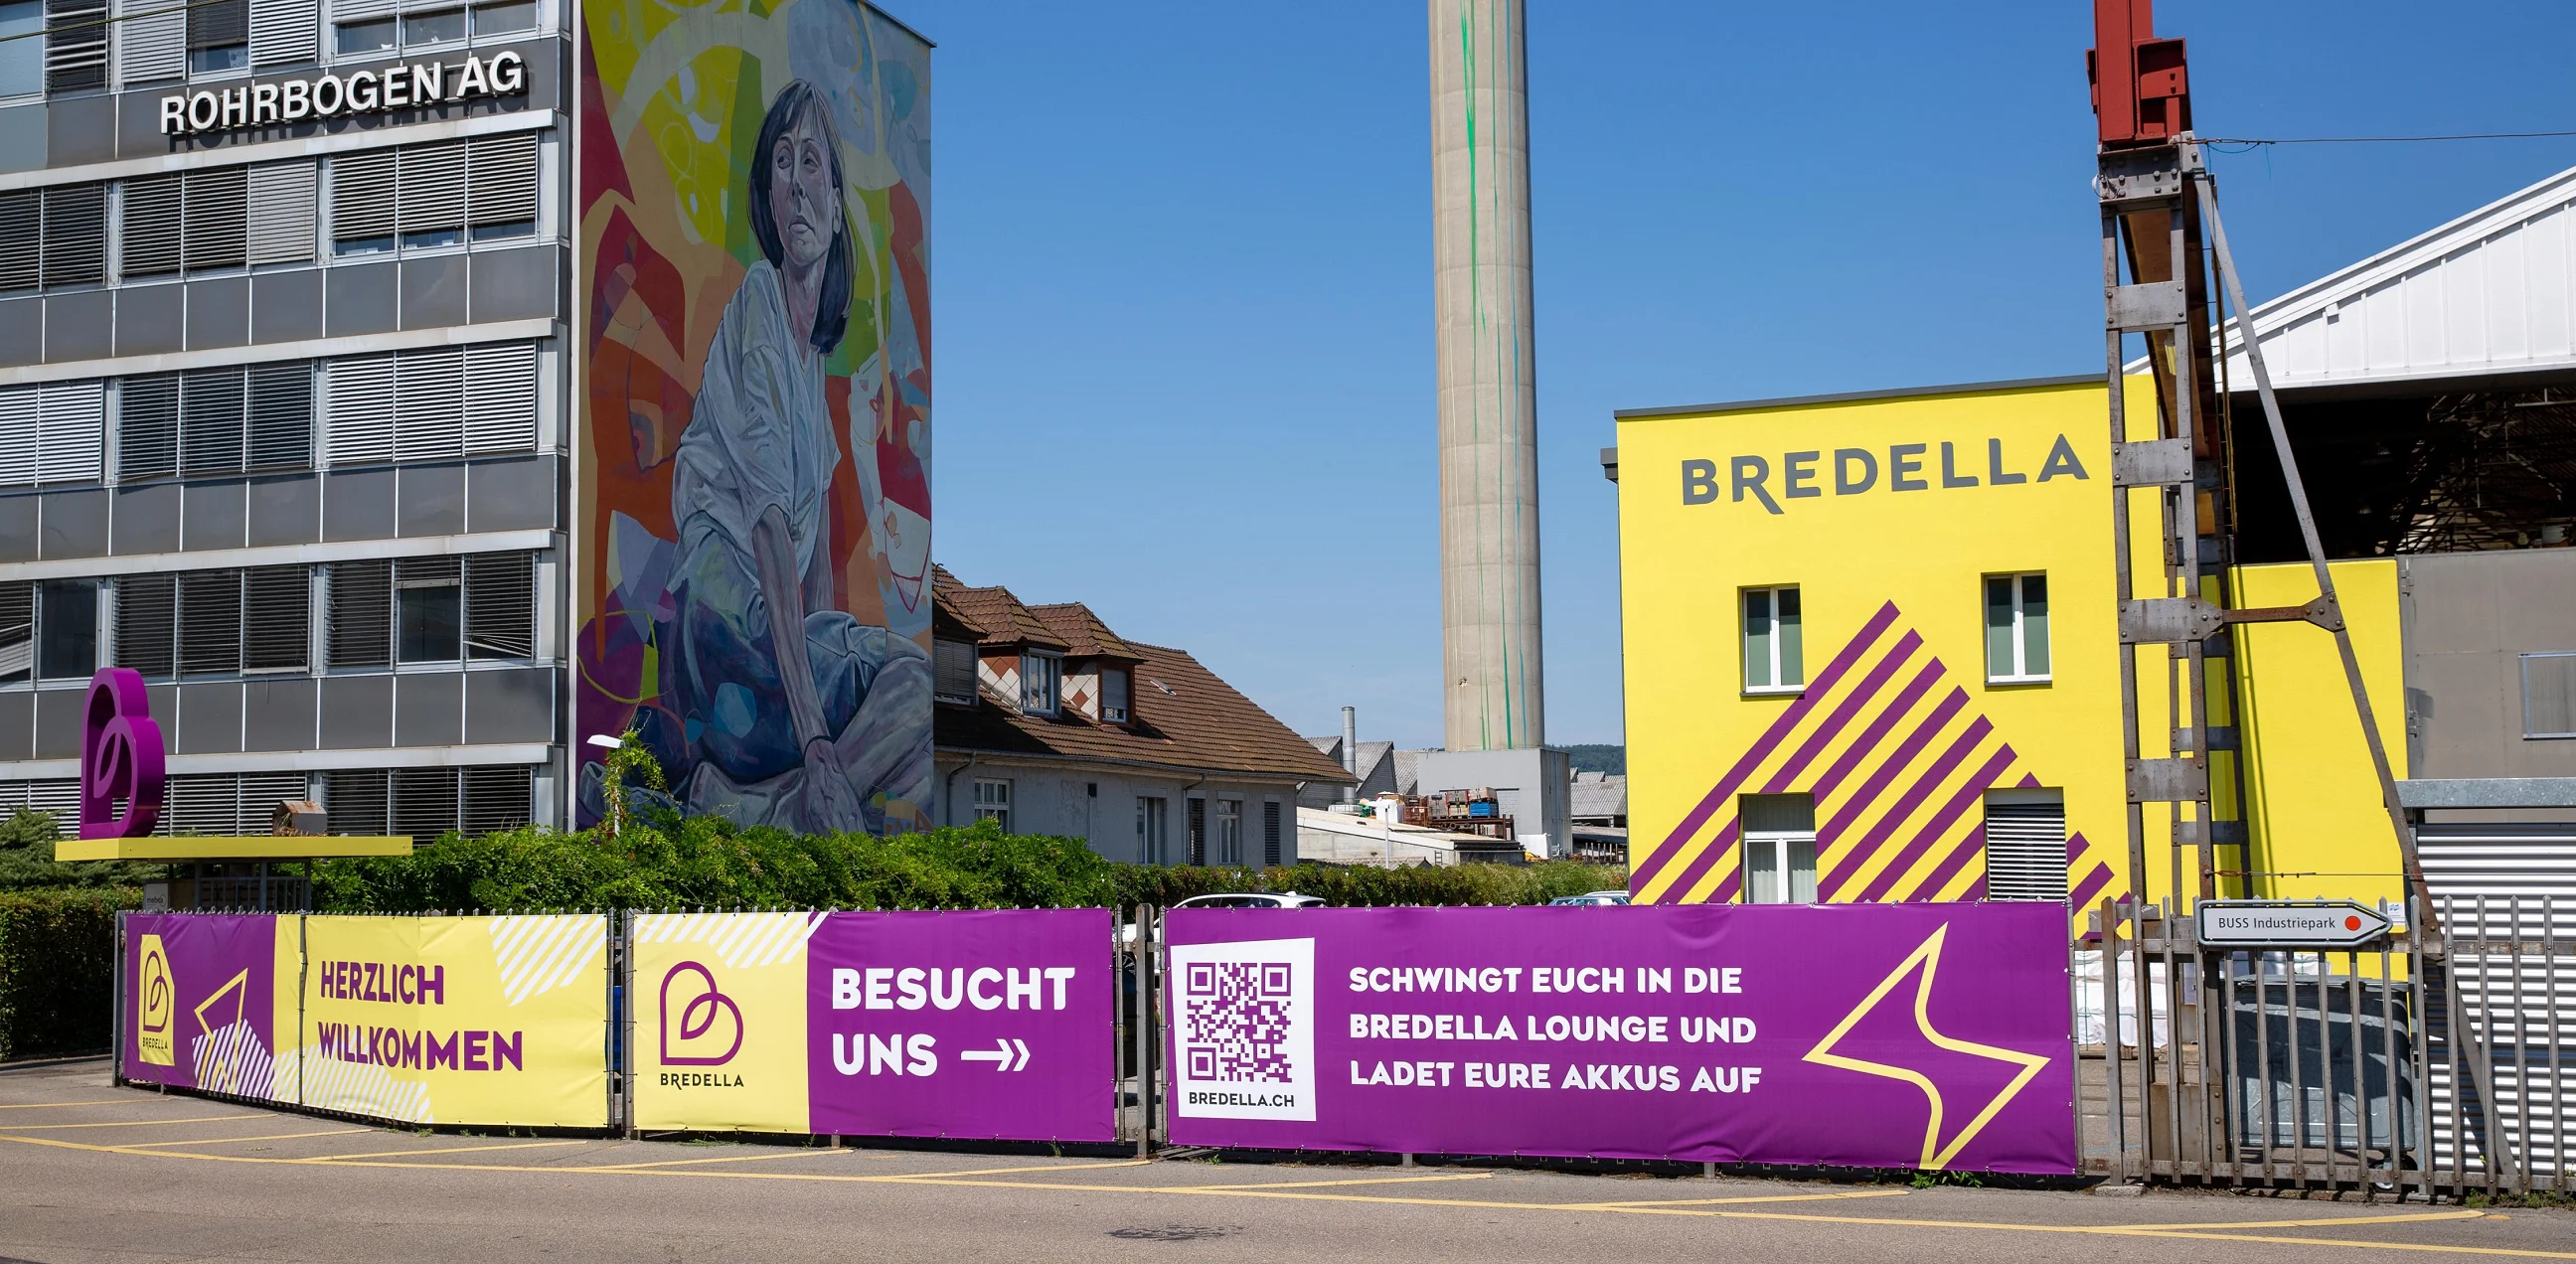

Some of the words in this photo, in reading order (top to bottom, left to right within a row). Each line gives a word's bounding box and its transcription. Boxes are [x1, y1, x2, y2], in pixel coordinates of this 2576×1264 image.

[161, 62, 440, 134] ROHRBOGEN
[456, 51, 523, 97] AG
[1681, 433, 2090, 516] BREDELLA
[2218, 917, 2249, 929] BUSS
[2253, 916, 2335, 931] Industriepark
[320, 960, 444, 1006] HERZLICH
[832, 967, 1075, 1011] BESUCHT
[1349, 966, 1523, 994] SCHWINGT
[1531, 966, 1625, 994] EUCH
[1637, 967, 1672, 994] IN
[1684, 967, 1742, 994] DIE
[142, 1036, 169, 1051] BREDELLA
[1350, 1014, 1519, 1040] BREDELLA
[1528, 1015, 1669, 1042] LOUNGE
[1680, 1017, 1757, 1043] UND
[317, 1021, 523, 1072] WILLKOMMEN
[832, 1032, 938, 1077] UNS
[660, 1072, 744, 1091] BREDELLA
[1351, 1059, 1455, 1087] LADET
[1464, 1062, 1551, 1089] EURE
[1560, 1063, 1681, 1092] AKKUS
[1690, 1066, 1762, 1093] AUF
[1189, 1091, 1295, 1108] BREDELLA.CH
